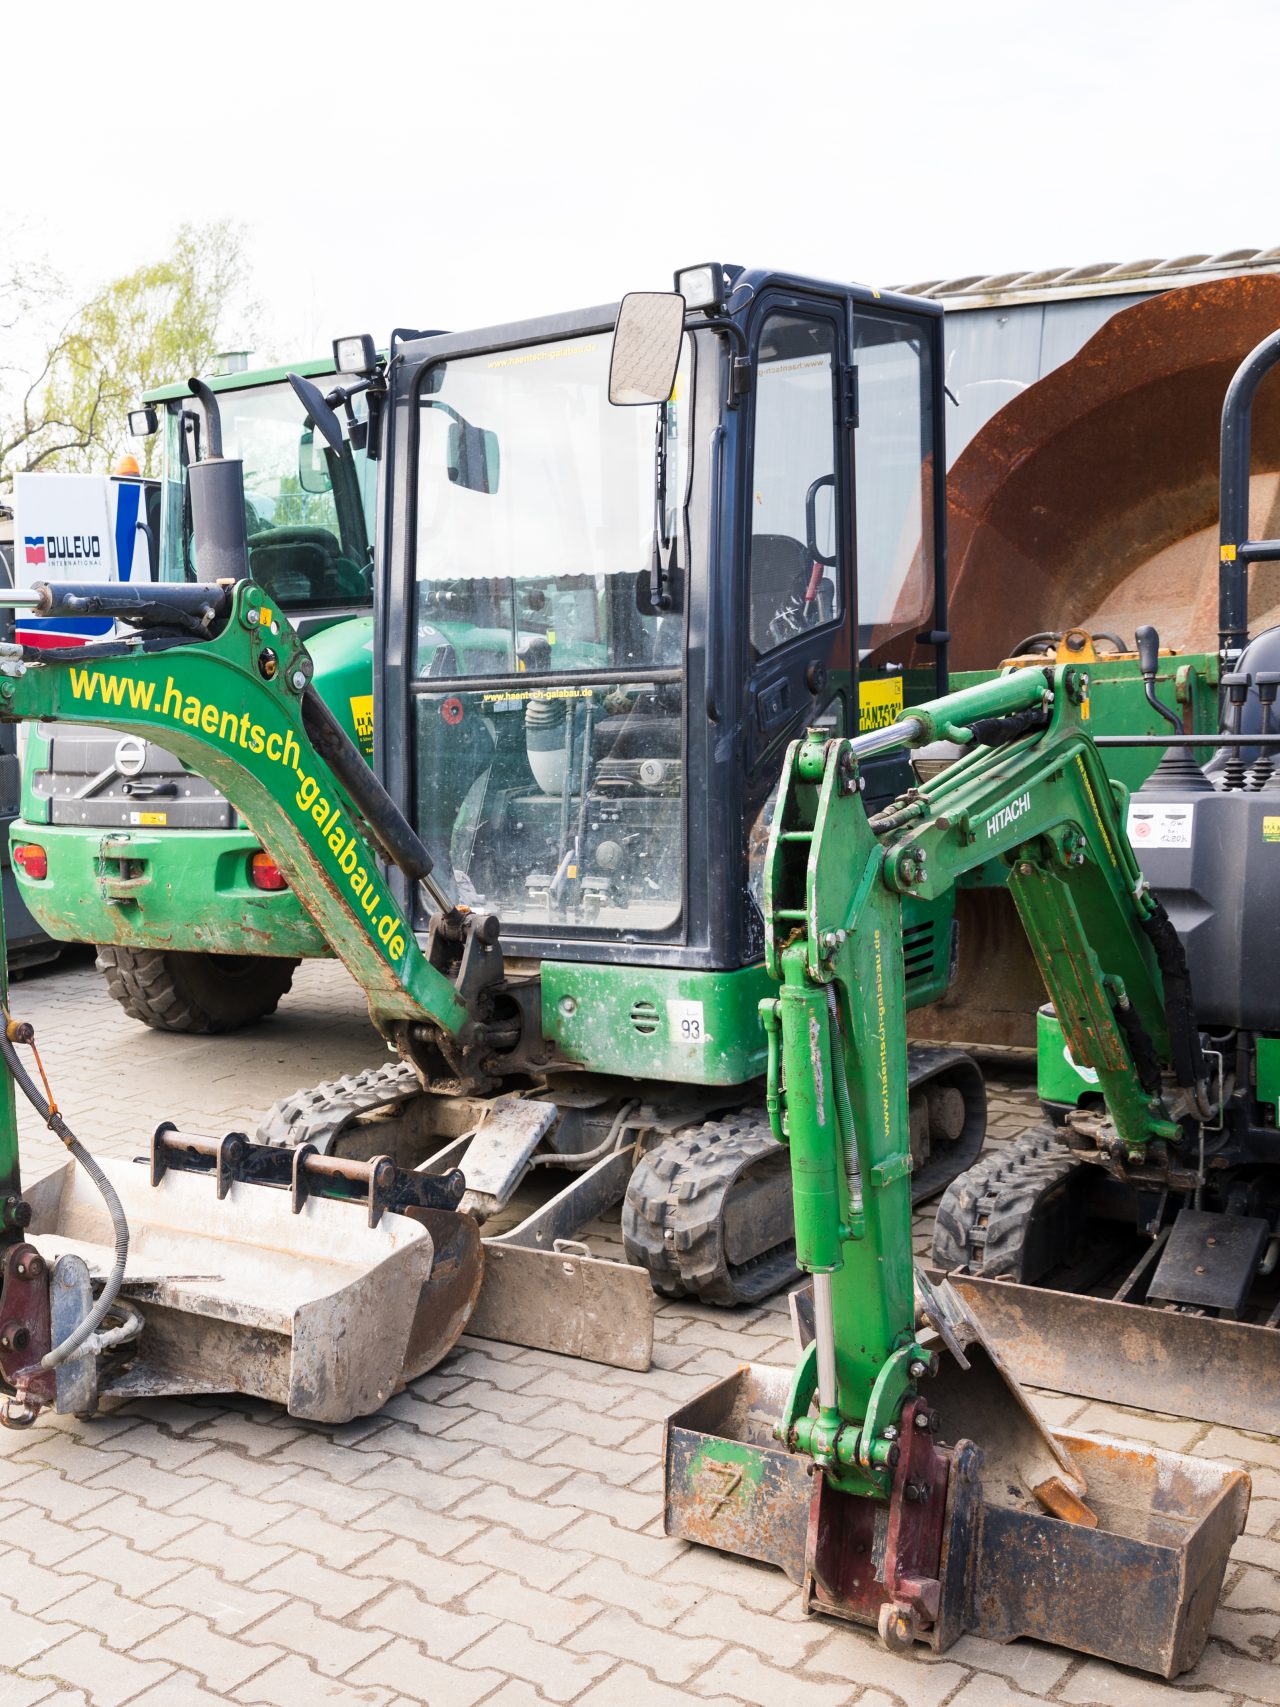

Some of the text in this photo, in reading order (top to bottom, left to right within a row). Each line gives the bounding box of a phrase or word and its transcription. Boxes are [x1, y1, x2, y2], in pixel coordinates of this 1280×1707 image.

[46, 535, 101, 558] DULEVO
[47, 559, 102, 567] INTERNATIONAL
[69, 666, 406, 962] www.haentsch-galabau.de
[986, 791, 1031, 839] HITACHI
[681, 1019, 700, 1040] 93
[873, 928, 891, 1138] www.haentsch-galabau.de
